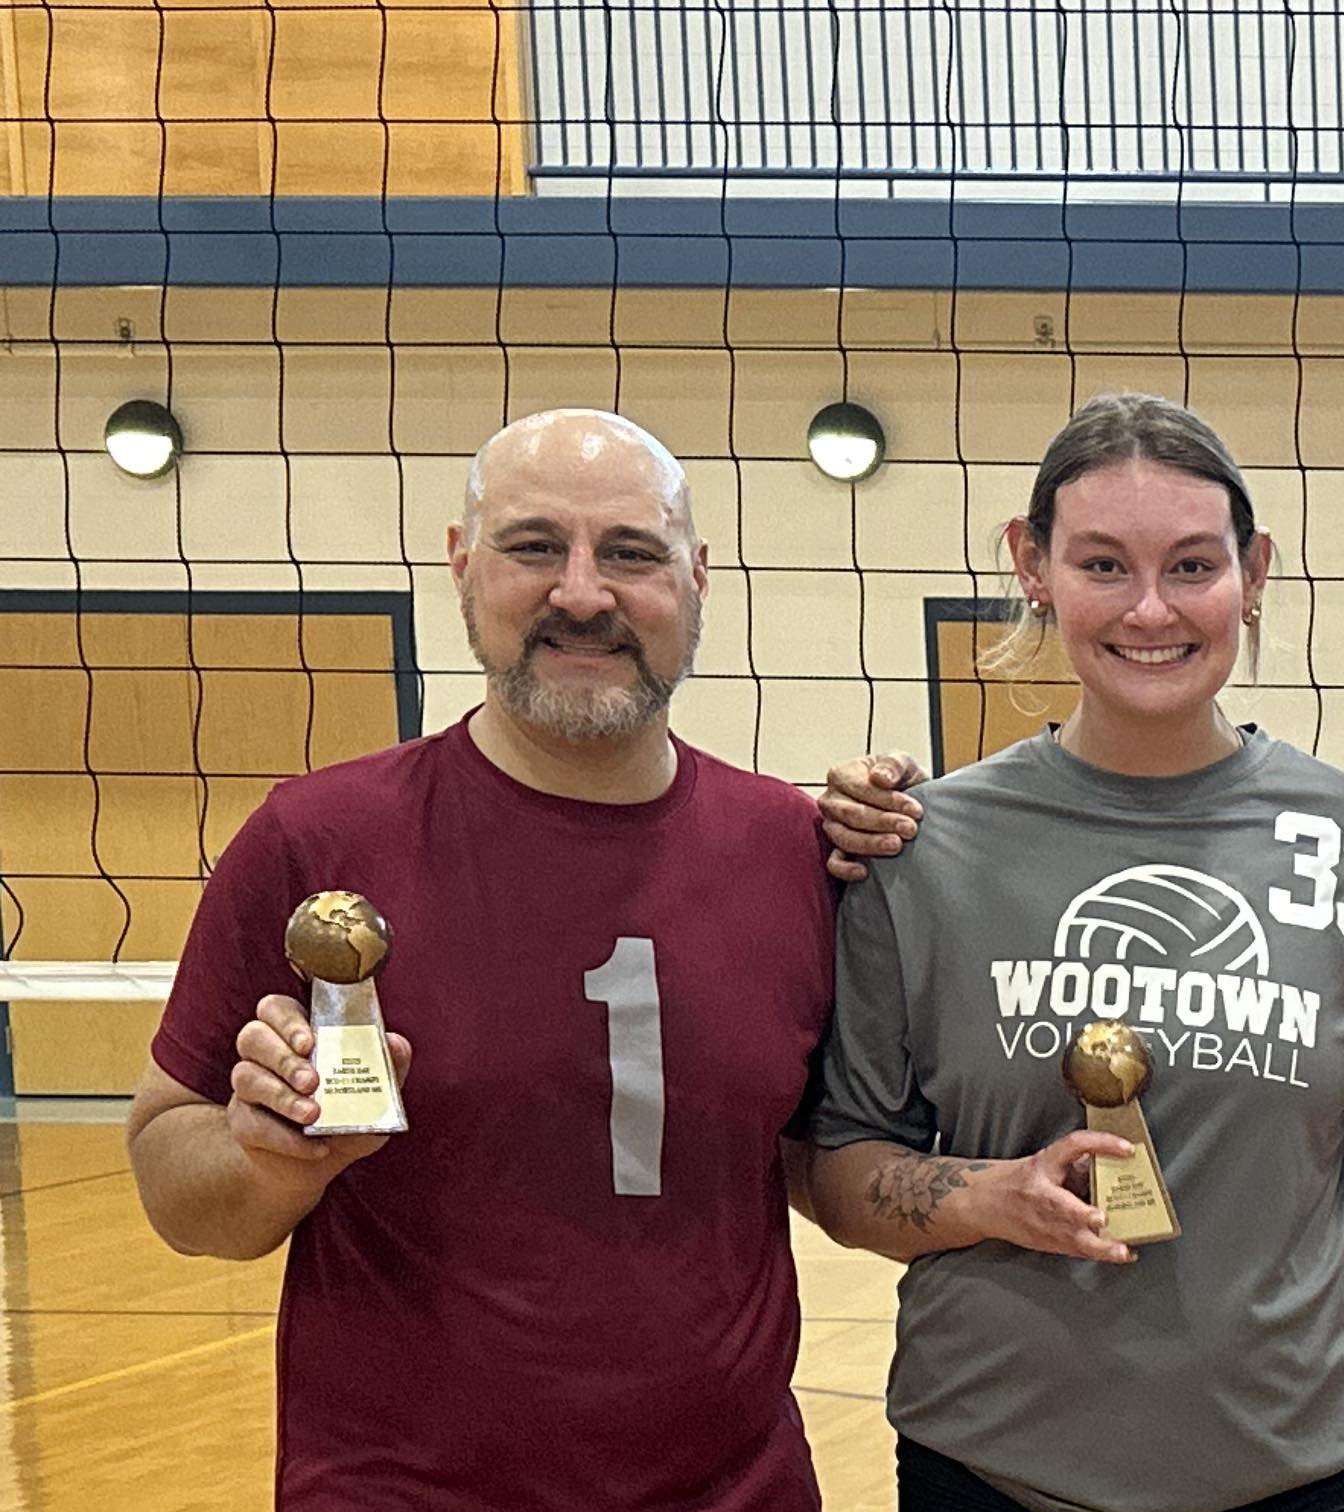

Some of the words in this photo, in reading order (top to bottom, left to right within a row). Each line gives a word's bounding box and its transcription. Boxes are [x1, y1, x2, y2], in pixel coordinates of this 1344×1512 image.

[990, 959, 1320, 1049] WOOTOWN
[584, 936, 666, 1196] 1
[995, 1020, 1310, 1089] VOYBALL
